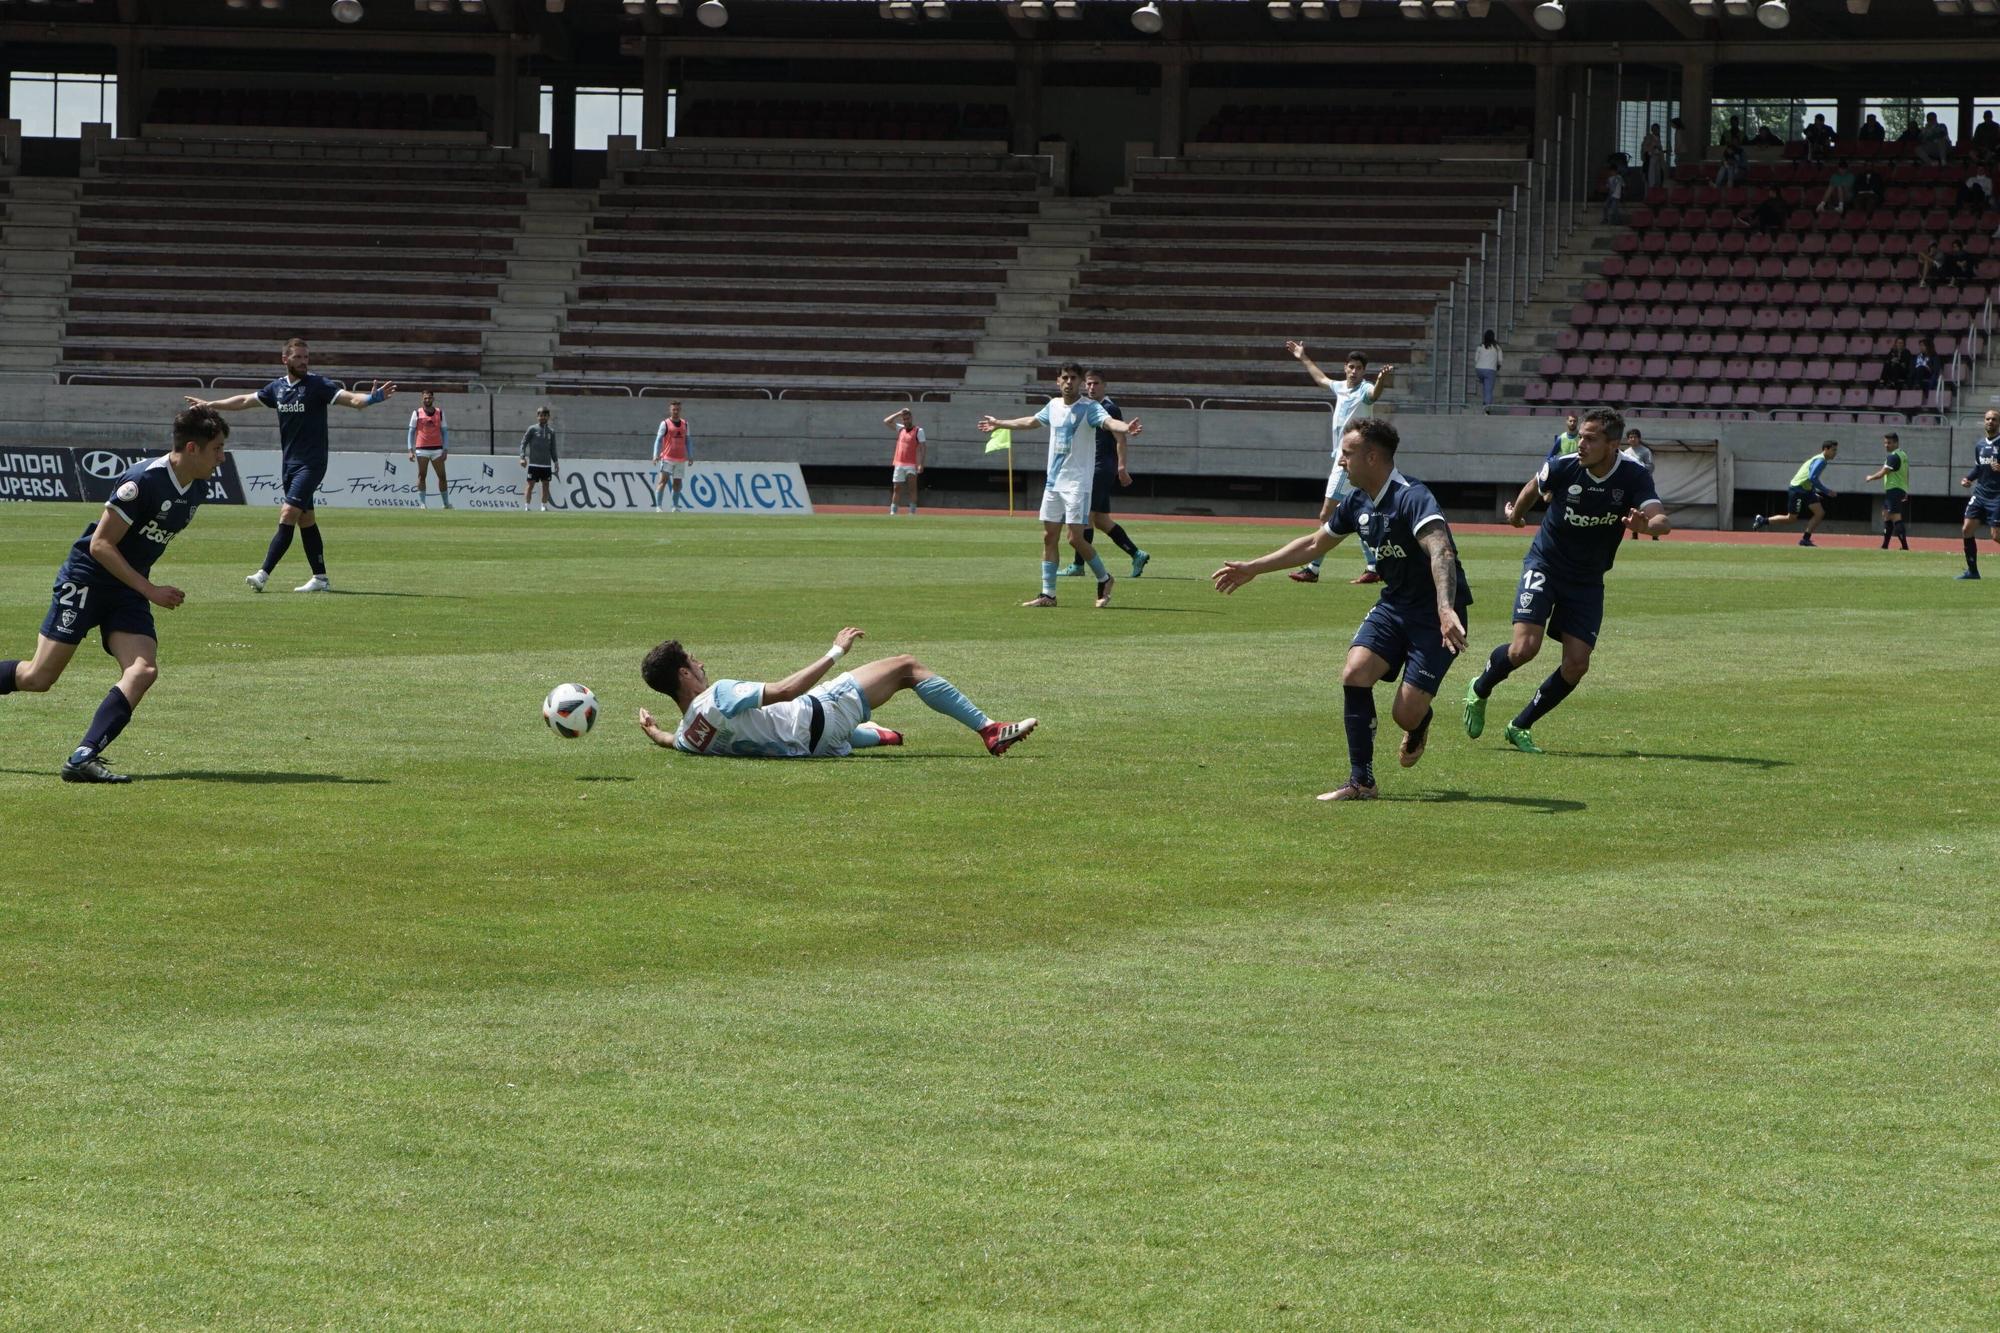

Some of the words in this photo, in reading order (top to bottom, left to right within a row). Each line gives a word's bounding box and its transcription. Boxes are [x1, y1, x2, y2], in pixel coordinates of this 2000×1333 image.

[367, 498, 420, 508] CONSERVAS
[469, 500, 520, 509] CONSERVAS
[1523, 569, 1546, 592] 12
[59, 582, 89, 609] 21
